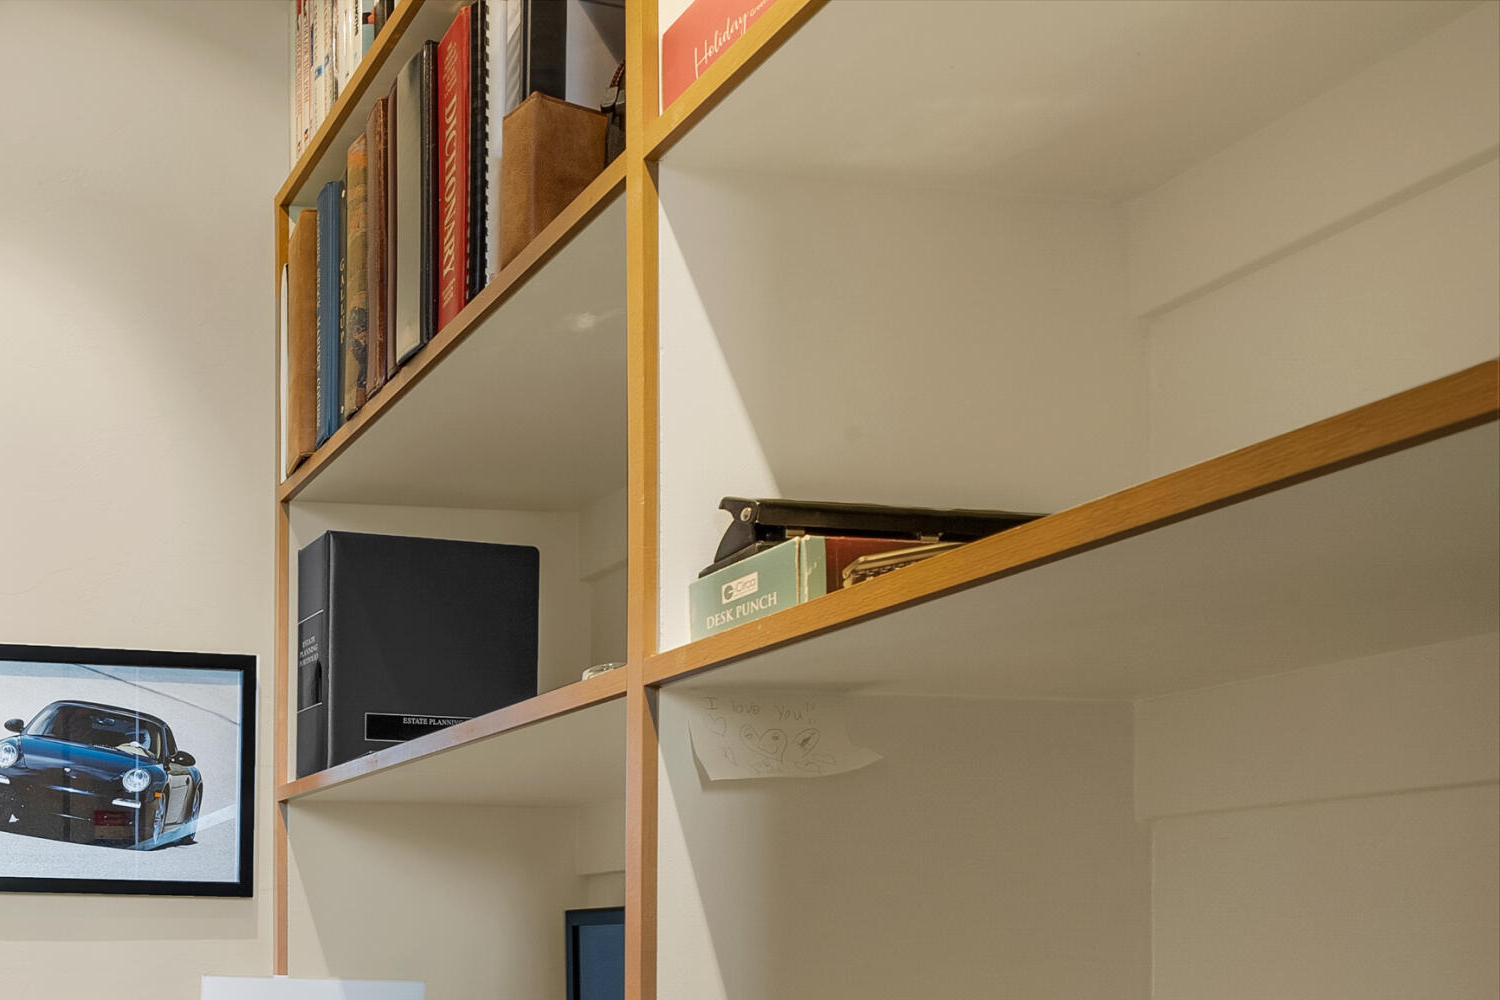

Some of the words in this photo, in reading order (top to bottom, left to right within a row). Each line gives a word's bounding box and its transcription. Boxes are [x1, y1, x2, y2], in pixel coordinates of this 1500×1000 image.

[694, 13, 748, 80] Holiday
[442, 94, 458, 280] DICTIONARY
[706, 608, 734, 629] DESK
[736, 591, 777, 619] PUNCH
[402, 717, 428, 725] ESTATE
